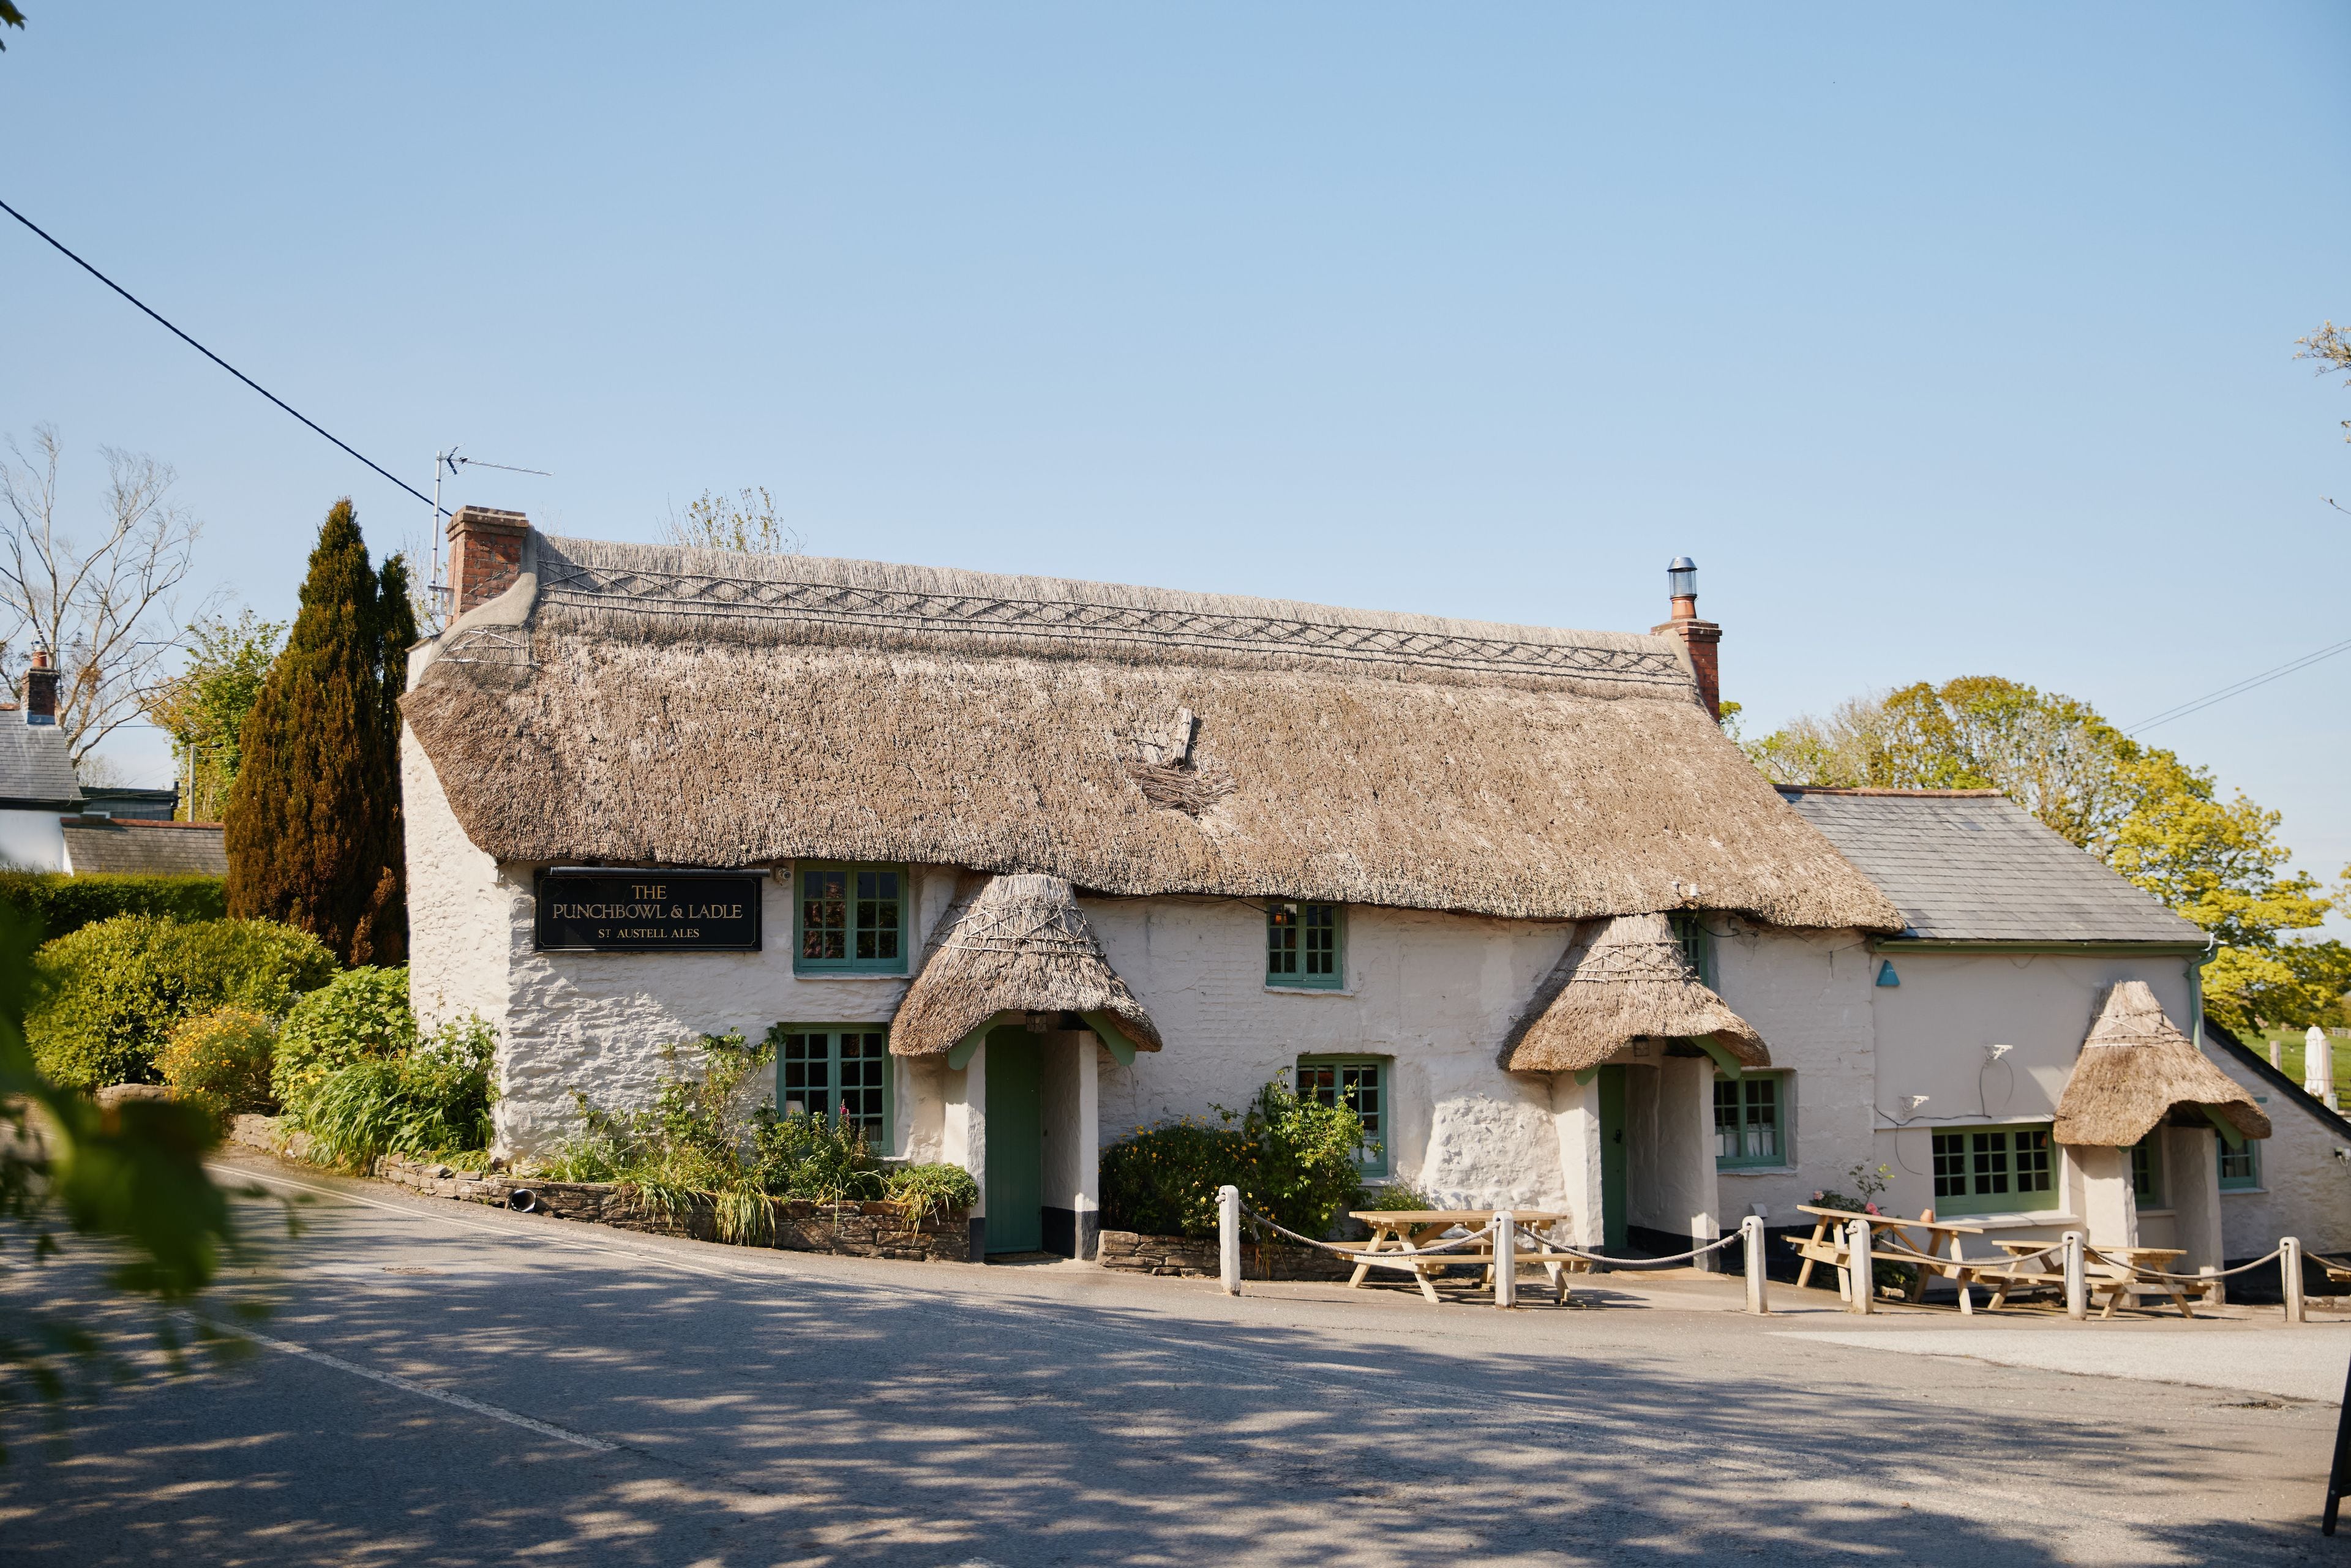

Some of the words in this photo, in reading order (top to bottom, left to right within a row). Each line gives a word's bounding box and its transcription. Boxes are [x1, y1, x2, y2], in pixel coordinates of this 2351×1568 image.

[632, 885, 667, 899] THE
[553, 904, 666, 919] PUNCHBOWL
[670, 904, 684, 919] &
[689, 904, 743, 919] LADLE
[617, 929, 667, 939] AUSTELL
[671, 929, 700, 939] ALES
